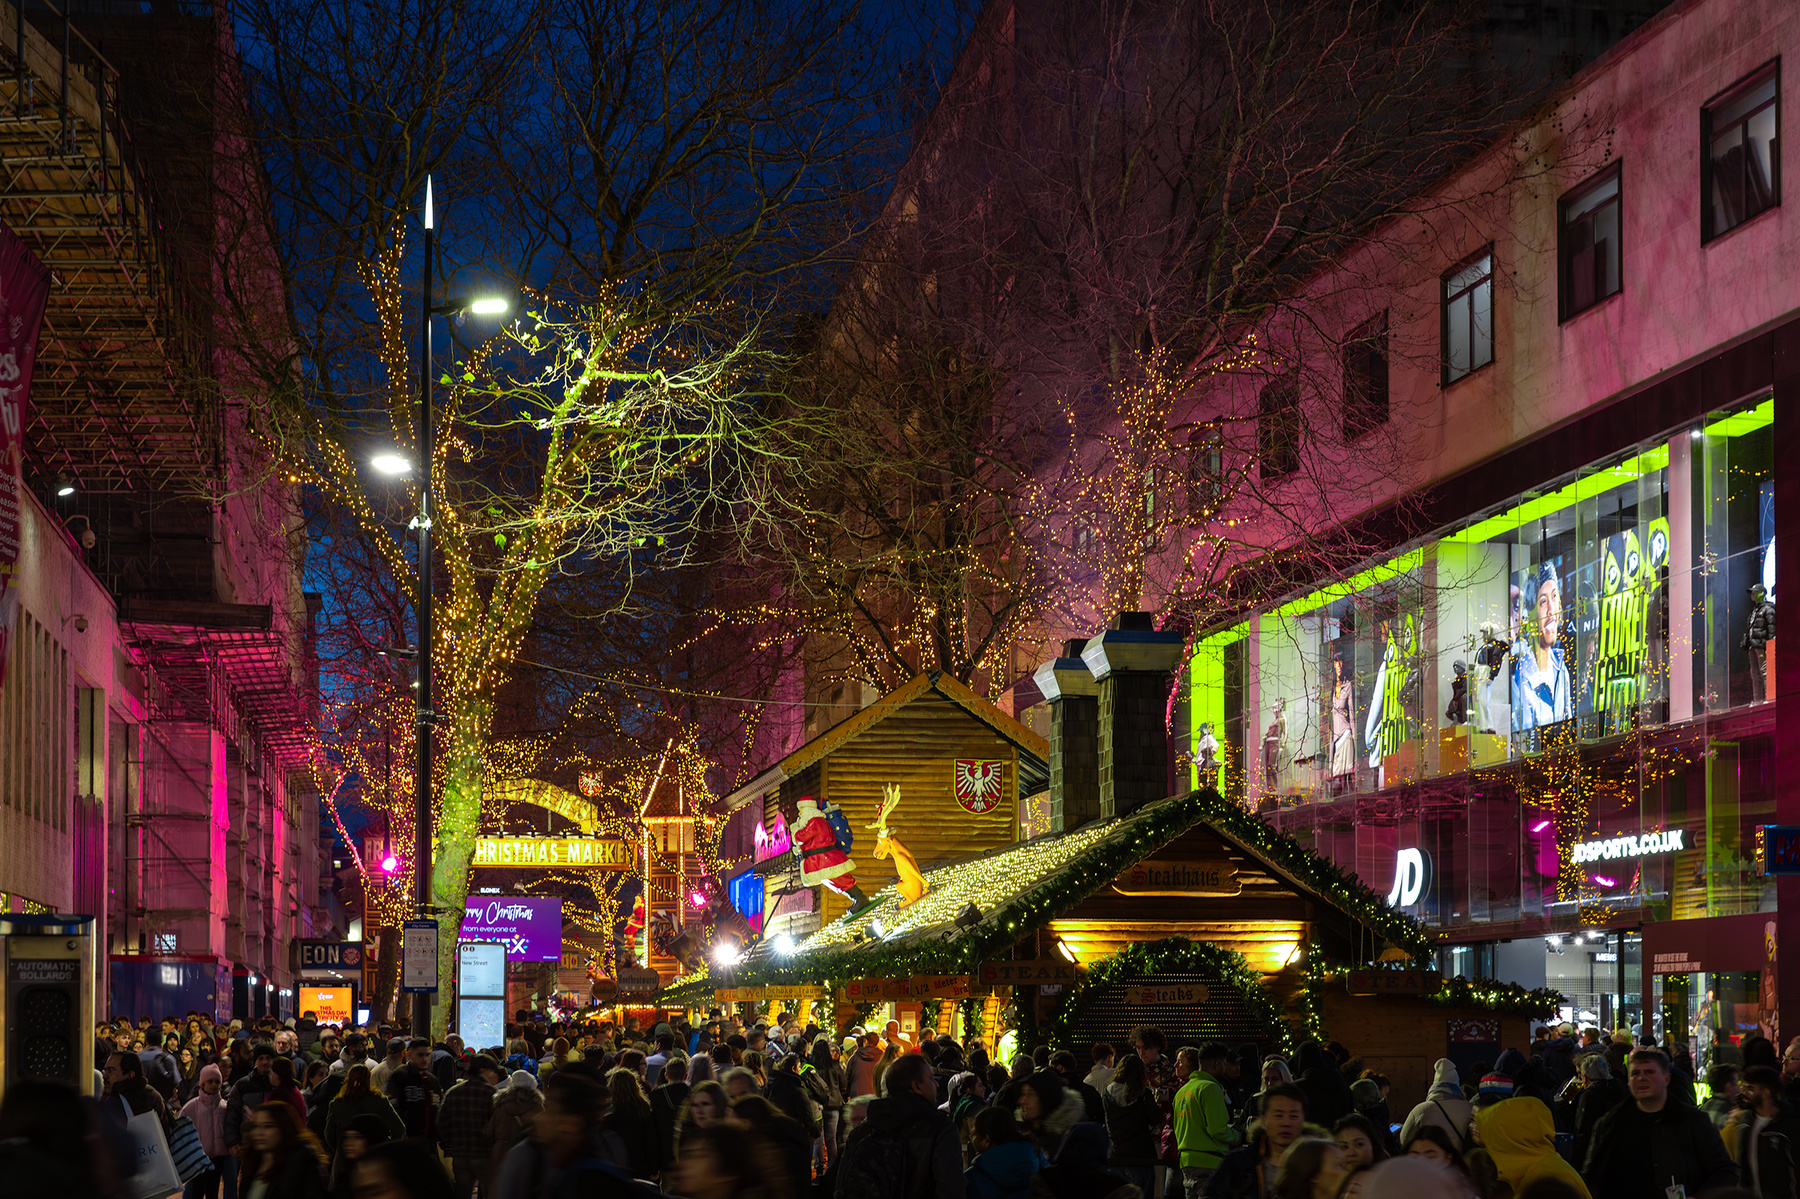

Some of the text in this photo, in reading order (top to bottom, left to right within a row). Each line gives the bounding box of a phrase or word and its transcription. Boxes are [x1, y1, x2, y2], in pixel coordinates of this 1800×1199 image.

[473, 842, 559, 863] HRISTMAS
[1571, 829, 1684, 863] JDSPORTS.CO.UK
[1131, 864, 1220, 891] Steakhaus
[1388, 847, 1423, 907] JD
[486, 901, 533, 925] Christmas
[303, 945, 340, 965] EON
[17, 962, 76, 971] AUTOMATIC
[984, 966, 1070, 980] STEAK
[19, 971, 73, 980] BOLLARDS
[934, 977, 958, 990] Meter
[1352, 974, 1438, 989] STEAK
[915, 984, 930, 995] 1/2
[1141, 987, 1194, 1003] Steaks
